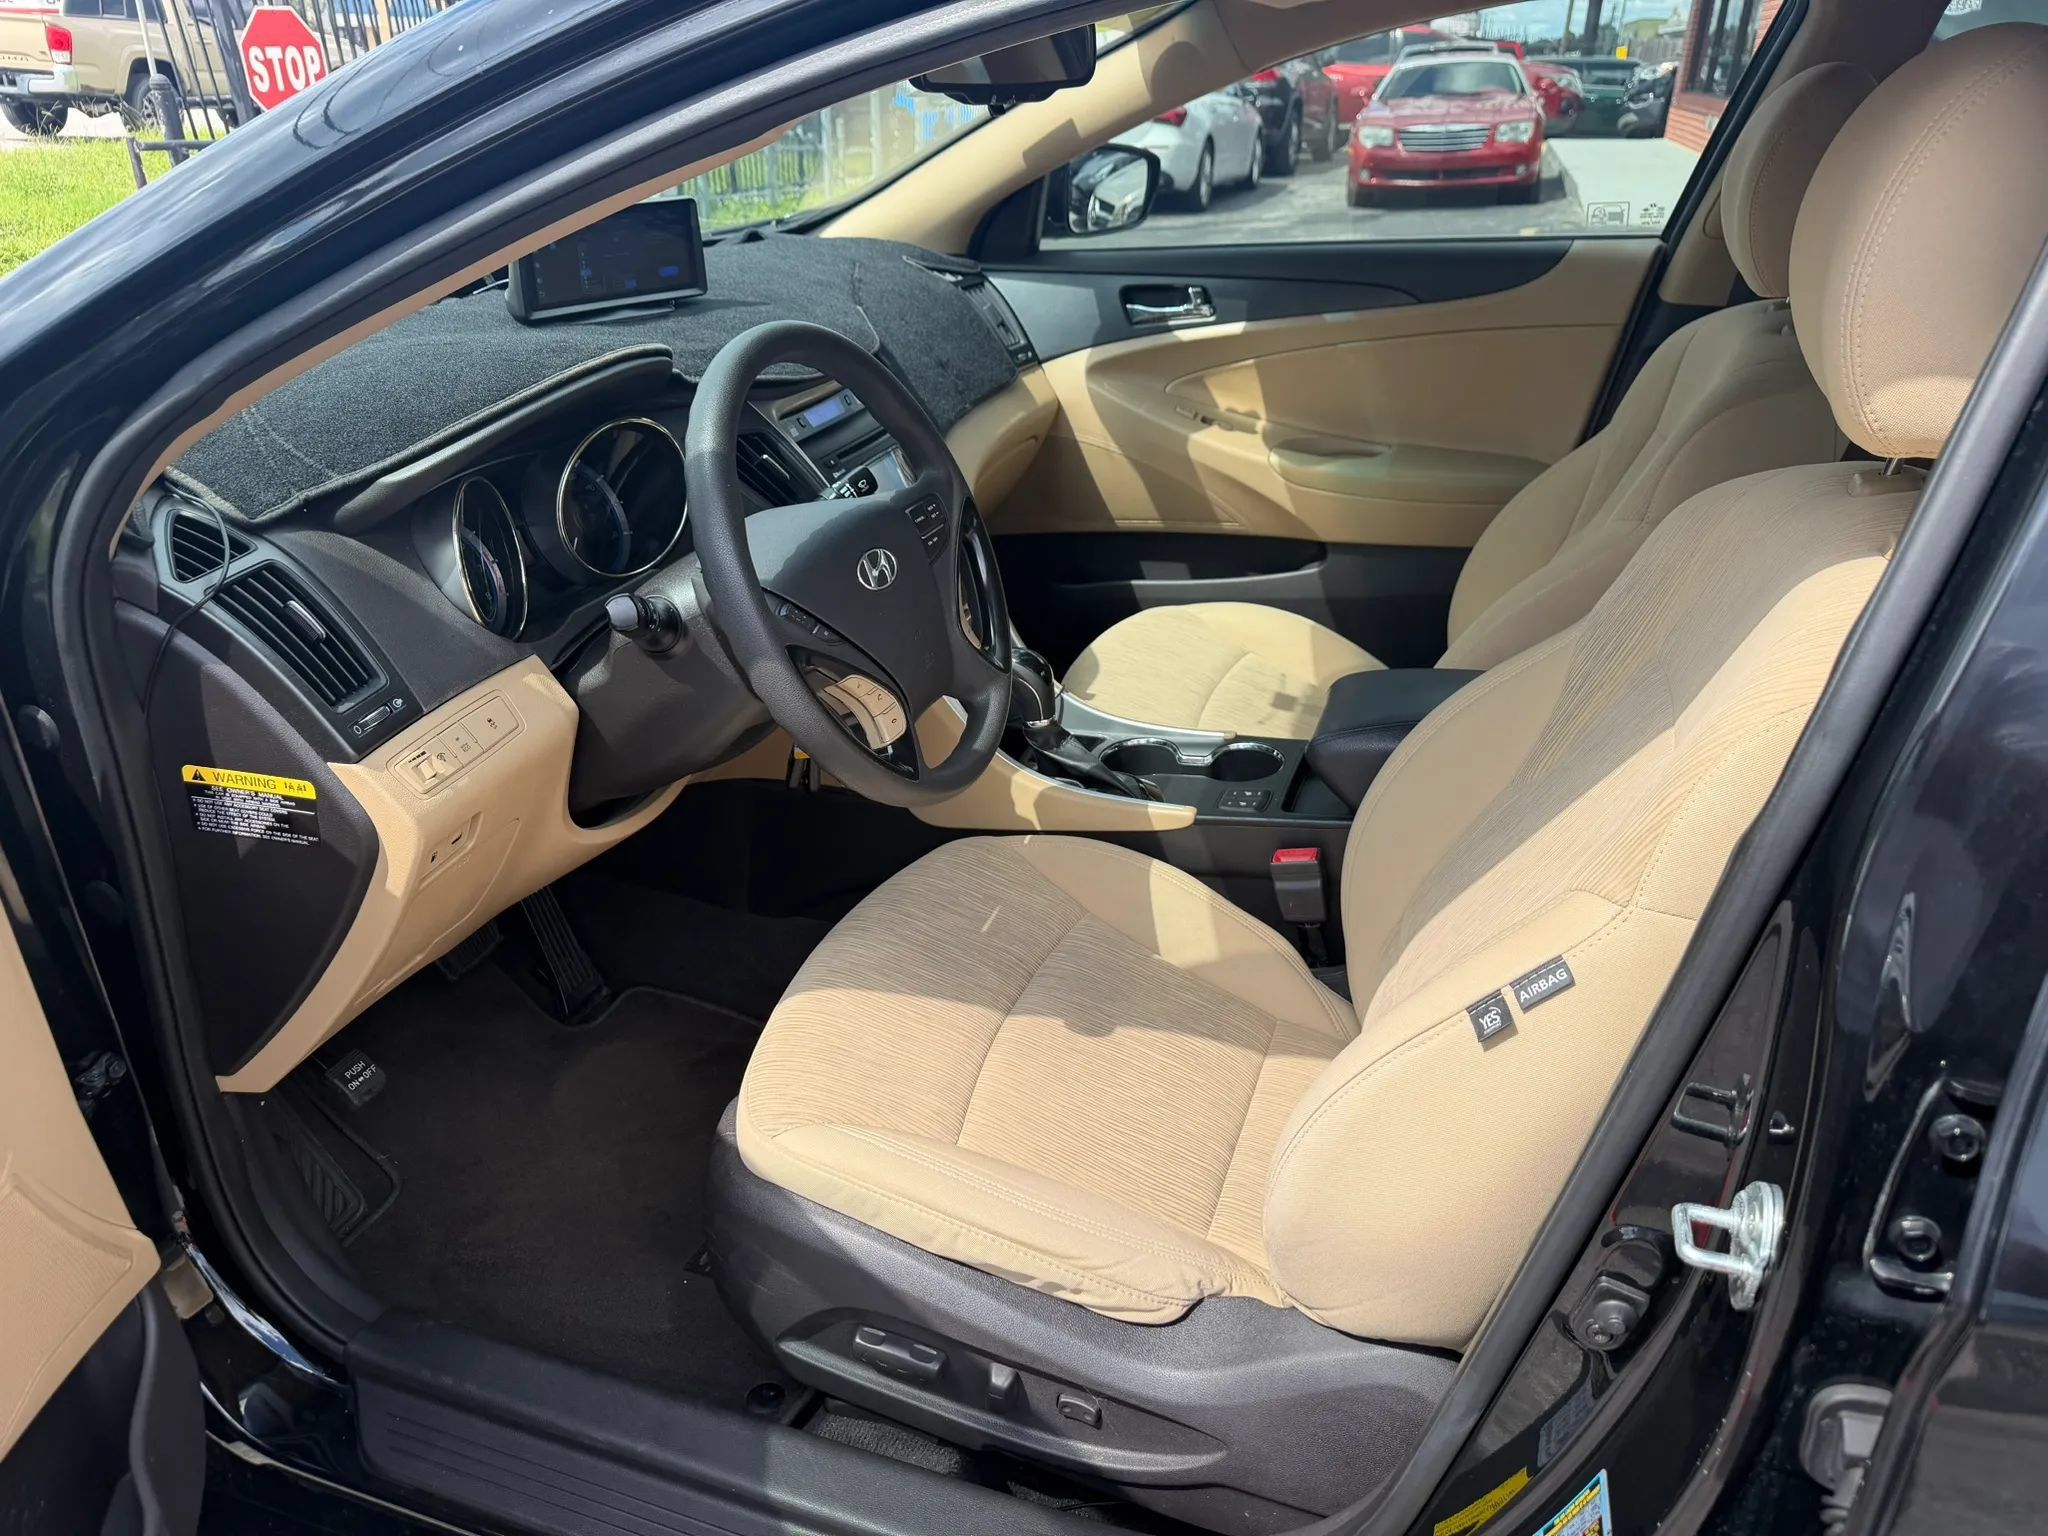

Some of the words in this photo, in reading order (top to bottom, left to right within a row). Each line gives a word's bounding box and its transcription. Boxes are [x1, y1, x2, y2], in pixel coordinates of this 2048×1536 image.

[248, 45, 321, 93] STOP
[212, 772, 277, 790] WARNING
[1520, 968, 1567, 1003] AIRBAG
[1479, 1010, 1501, 1030] YES
[345, 1061, 366, 1079] PUSH
[362, 1064, 376, 1079] OFF
